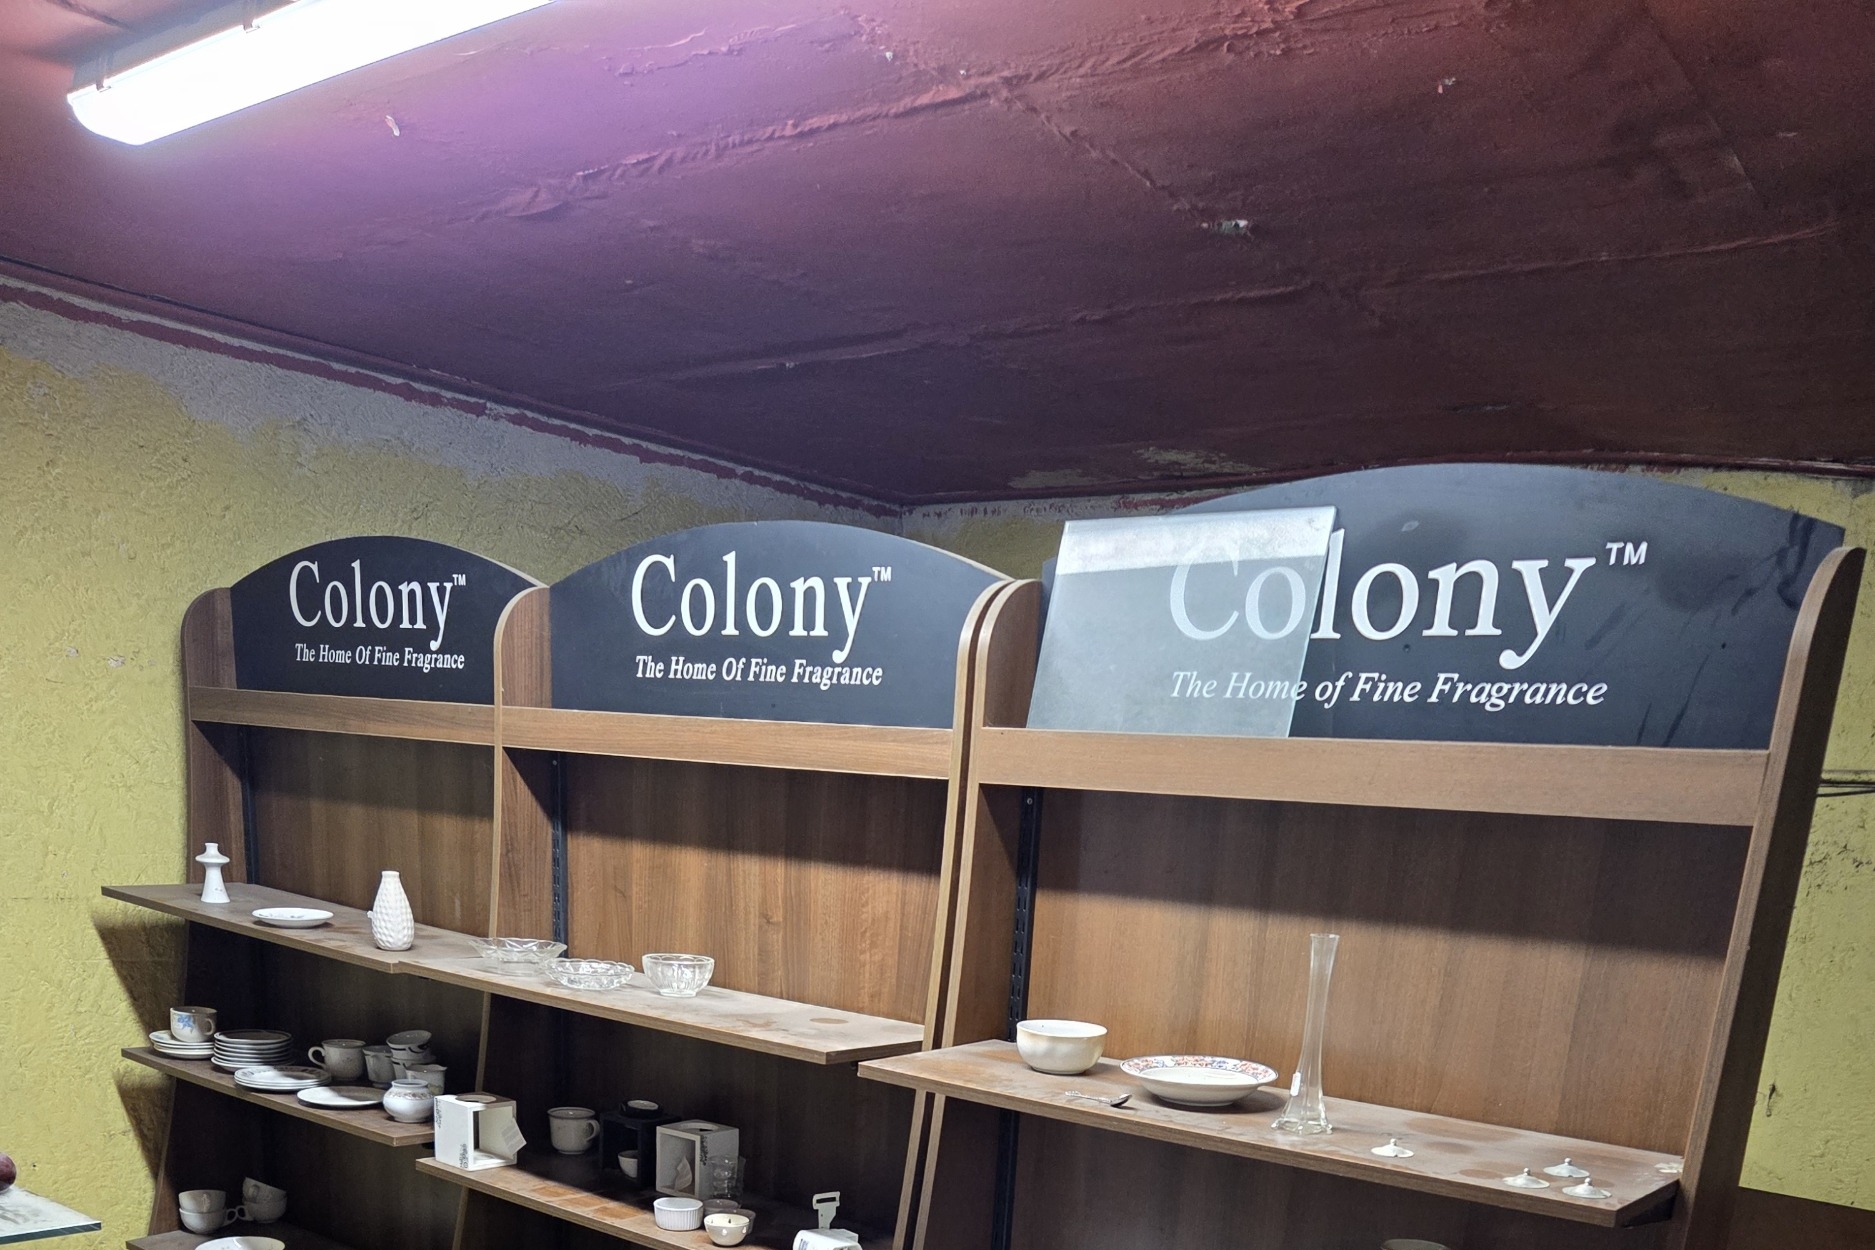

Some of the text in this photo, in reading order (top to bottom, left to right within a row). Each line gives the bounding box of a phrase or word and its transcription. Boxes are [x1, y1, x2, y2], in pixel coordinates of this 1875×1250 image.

[289, 558, 454, 652] Colony
[631, 550, 873, 666] Colony
[1169, 528, 1597, 670] Colony
[294, 643, 465, 674] The Home Of Fine Fragrance
[635, 655, 884, 691] The Home Of Fine Fragrance
[1169, 670, 1608, 712] The Home of Fine Fragrance
